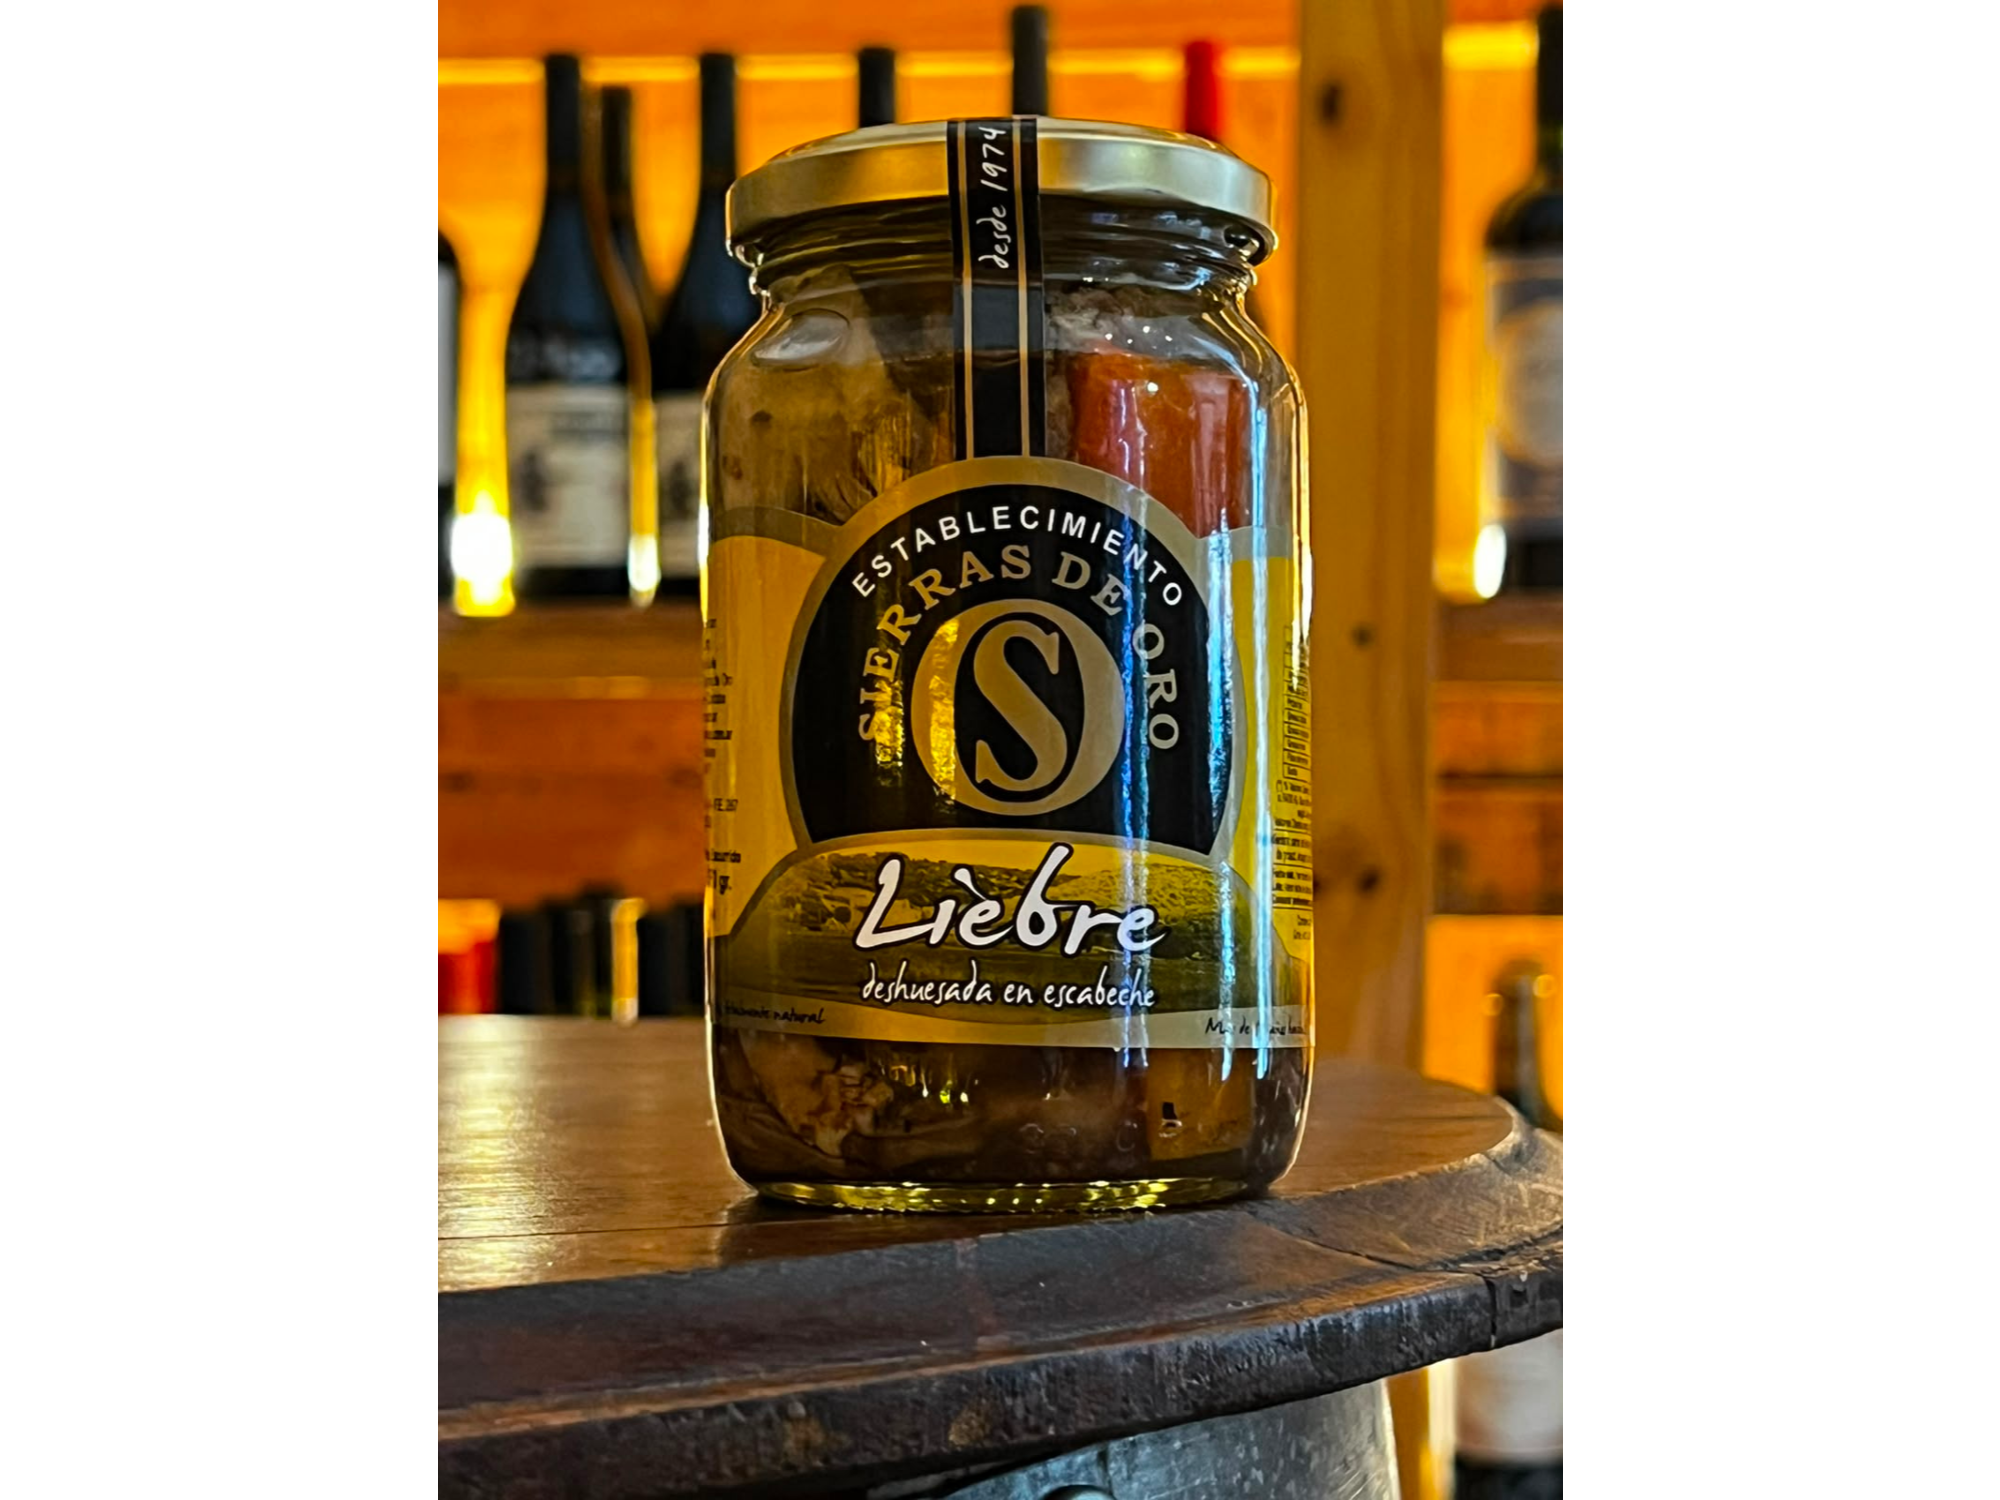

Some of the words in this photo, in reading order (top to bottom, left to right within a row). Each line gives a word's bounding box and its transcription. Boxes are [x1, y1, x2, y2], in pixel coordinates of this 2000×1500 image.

[978, 126, 1008, 192] 1974
[976, 204, 1011, 269] desde
[852, 505, 1183, 607] ESTABLECIMIENTO
[858, 543, 1031, 743] SIERRAS
[1052, 551, 1126, 616] DE
[1132, 622, 1180, 750] ORO
[862, 959, 993, 1005] deshuesada
[1003, 981, 1034, 1005] en
[1044, 965, 1156, 1008] escabeche
